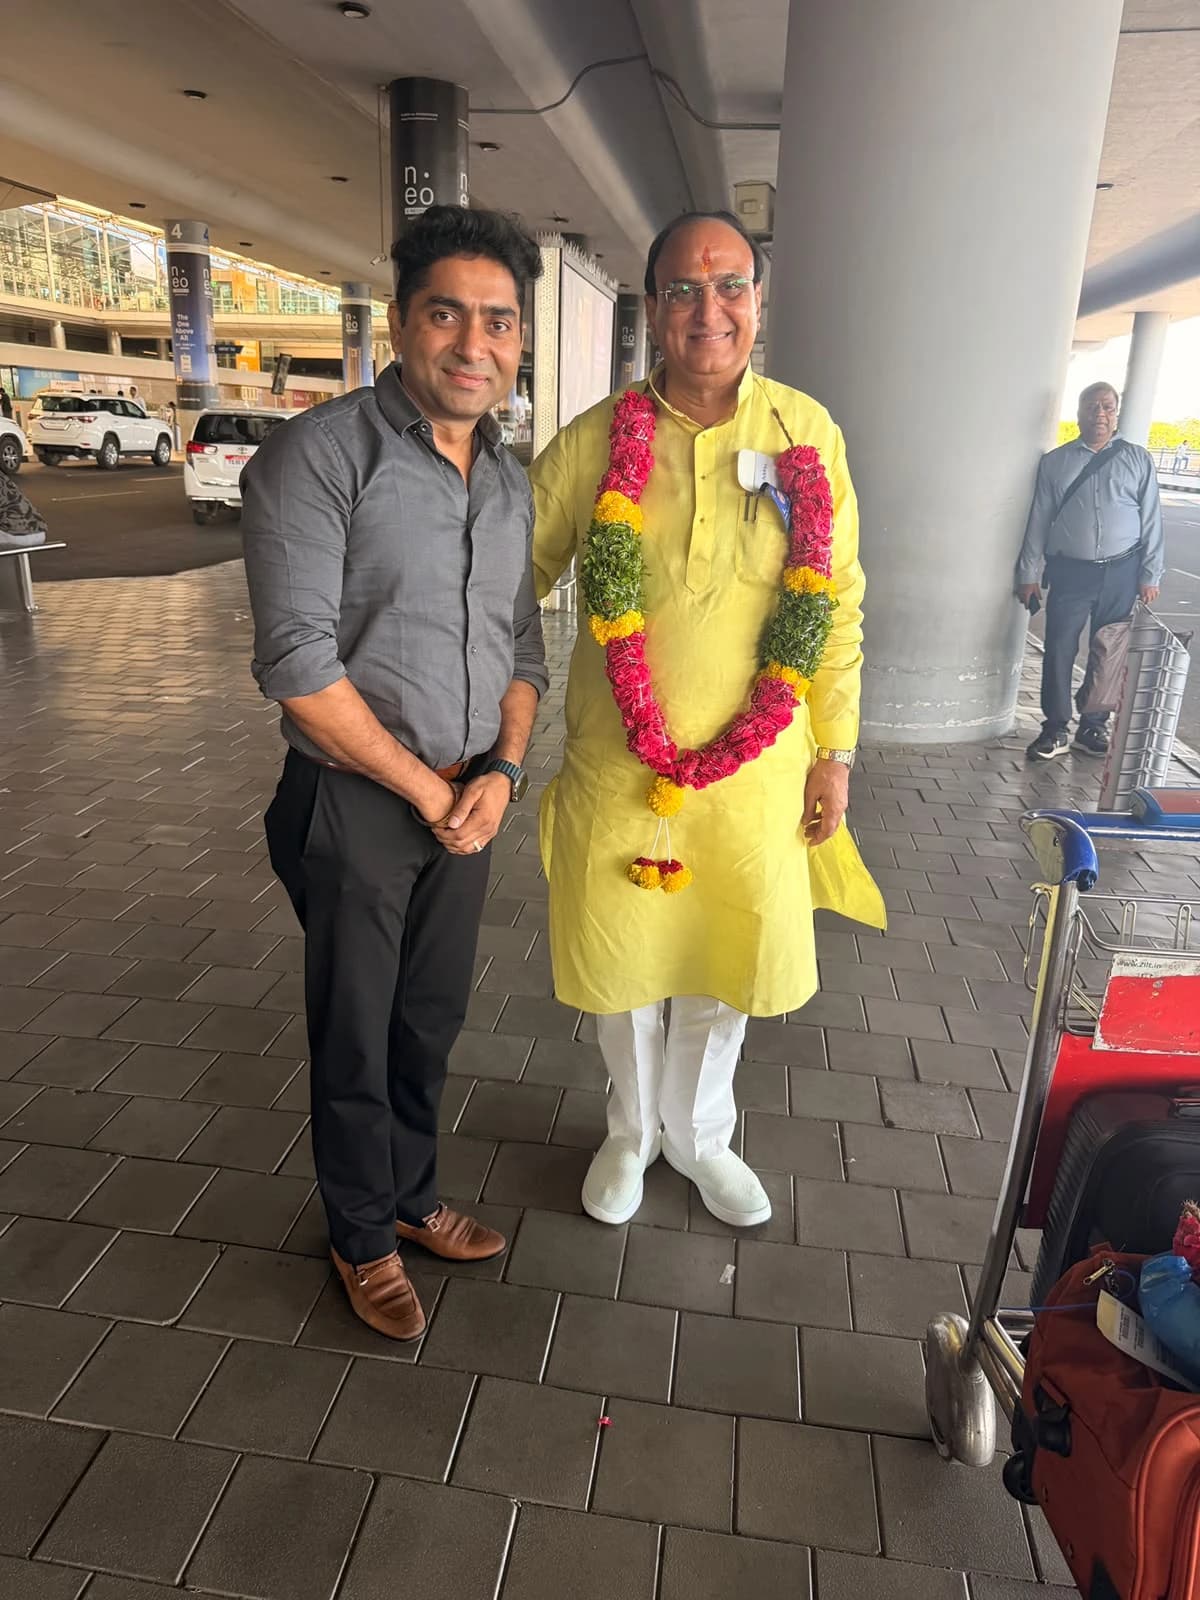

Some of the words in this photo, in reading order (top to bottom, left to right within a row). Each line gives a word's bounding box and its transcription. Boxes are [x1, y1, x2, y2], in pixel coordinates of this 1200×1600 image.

[404, 186, 434, 206] eo
[171, 223, 183, 239] 4
[172, 277, 189, 288] eo
[345, 321, 359, 329] eo
[622, 334, 635, 343] eo
